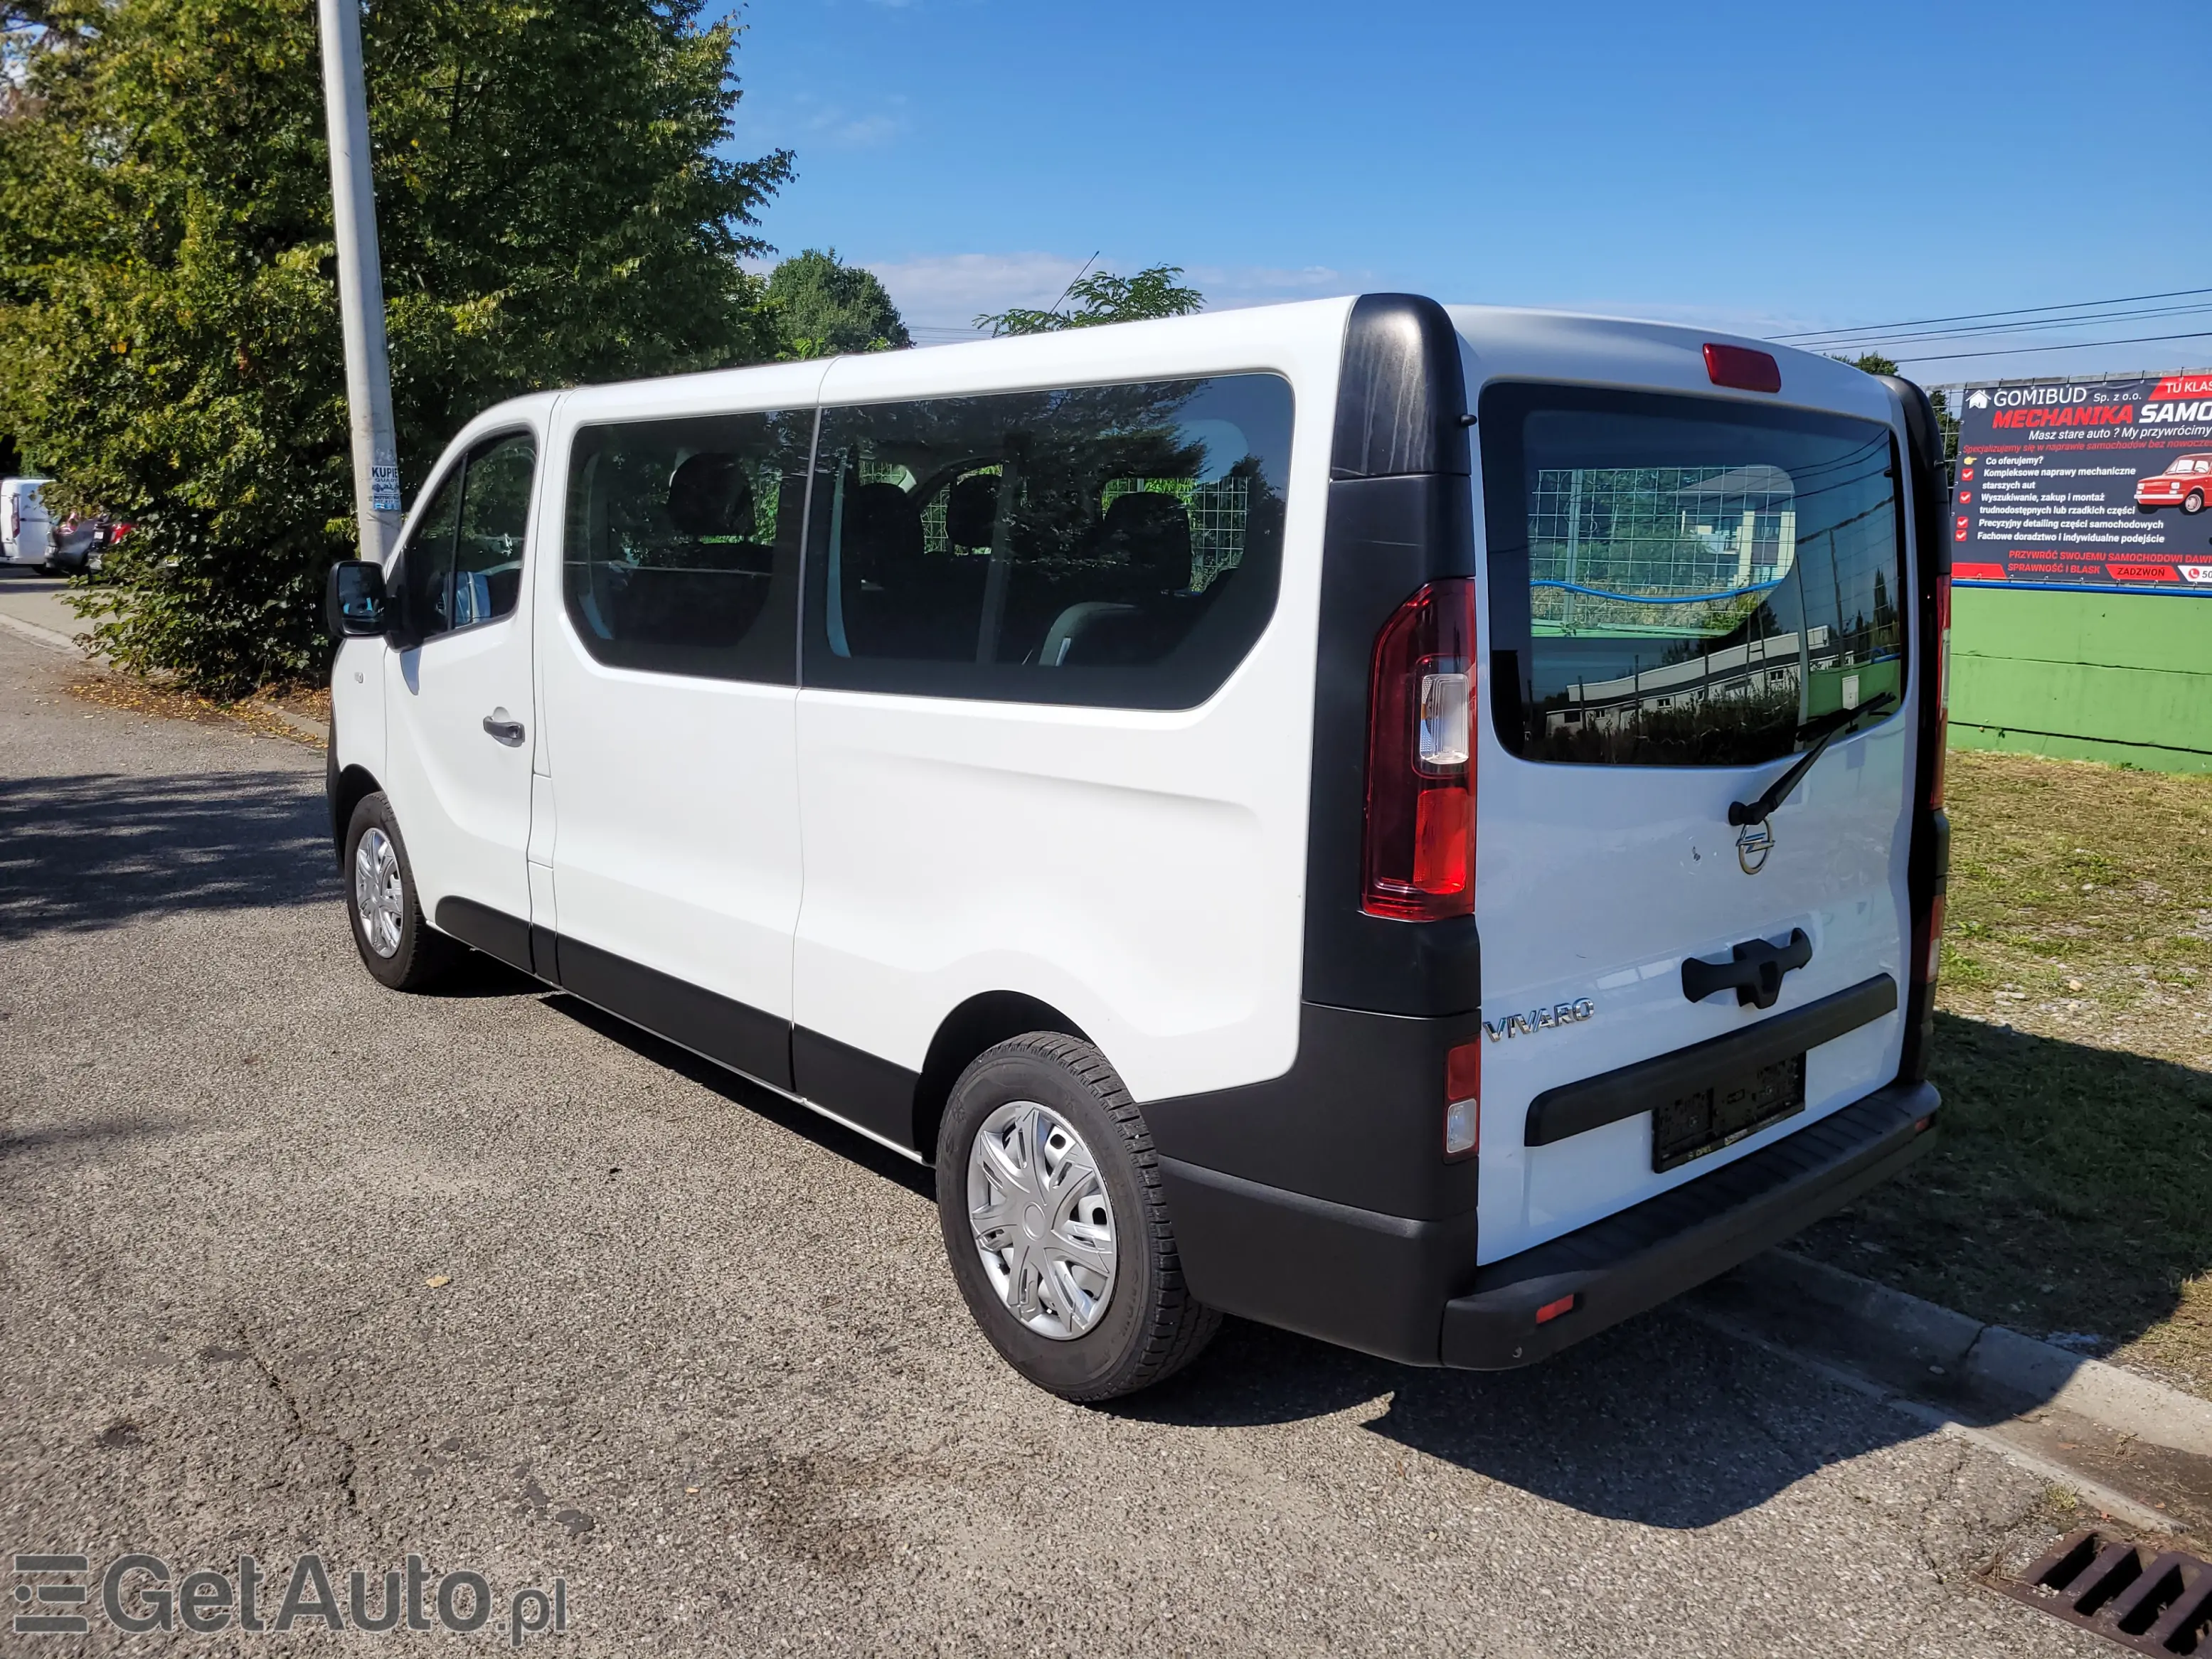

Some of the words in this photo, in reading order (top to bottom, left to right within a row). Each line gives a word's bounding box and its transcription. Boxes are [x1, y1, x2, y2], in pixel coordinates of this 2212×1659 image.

[2166, 382, 2181, 393] TU
[1994, 387, 2086, 407] GOMIBUD
[2093, 393, 2110, 403] Sp.
[2122, 393, 2142, 401] o.o.
[1992, 404, 2133, 429] MECHANIKA
[2139, 401, 2212, 423] SAMO
[2028, 430, 2056, 440] Masz
[2058, 429, 2085, 439] stare
[2087, 429, 2110, 439] auto
[2114, 427, 2120, 438] ?
[2121, 427, 2139, 439] My
[2139, 425, 2212, 439] przywrócimy
[1963, 444, 2021, 454] Specjalizujemy
[2023, 444, 2036, 453] się
[2046, 442, 2084, 452] naprawie
[2086, 440, 2146, 450] samochodów
[2148, 439, 2165, 449] bez
[1998, 456, 2043, 466] oferujemy?
[1984, 468, 2039, 478] Kompleksowe
[2041, 469, 2076, 478] naprawy
[2078, 467, 2136, 476] mechaniczne
[1982, 481, 2020, 491] starszych
[2021, 481, 2036, 489] aut
[1981, 493, 2039, 502] Wyszukiwanie,
[2041, 493, 2065, 502] zakup
[2068, 493, 2070, 501] i
[2073, 493, 2105, 501] montaż
[1979, 506, 2051, 516] trudnodostępnych
[2053, 506, 2067, 514] lub
[2068, 506, 2105, 514] rzadkich
[2107, 506, 2135, 516] części
[1979, 518, 2021, 528] Precyzyjny
[2023, 519, 2059, 529] detailing
[2061, 520, 2088, 529] części
[2089, 520, 2164, 530] samochodowych
[1977, 532, 2012, 540] Fachowe
[2014, 532, 2056, 541] doradztwo
[2063, 533, 2119, 543] indywidualne
[2121, 535, 2165, 544] podejście
[2009, 550, 2058, 560] PRZYWRÓĆ
[2060, 551, 2105, 561] SWOJEMU
[2107, 553, 2183, 562] SAMOCHODOWI
[2008, 562, 2063, 573] SPRAWNOŚĆ
[2070, 565, 2100, 574] BLASK
[2117, 567, 2165, 577] ZADZWOŃ
[1482, 997, 1595, 1042] VIVARO
